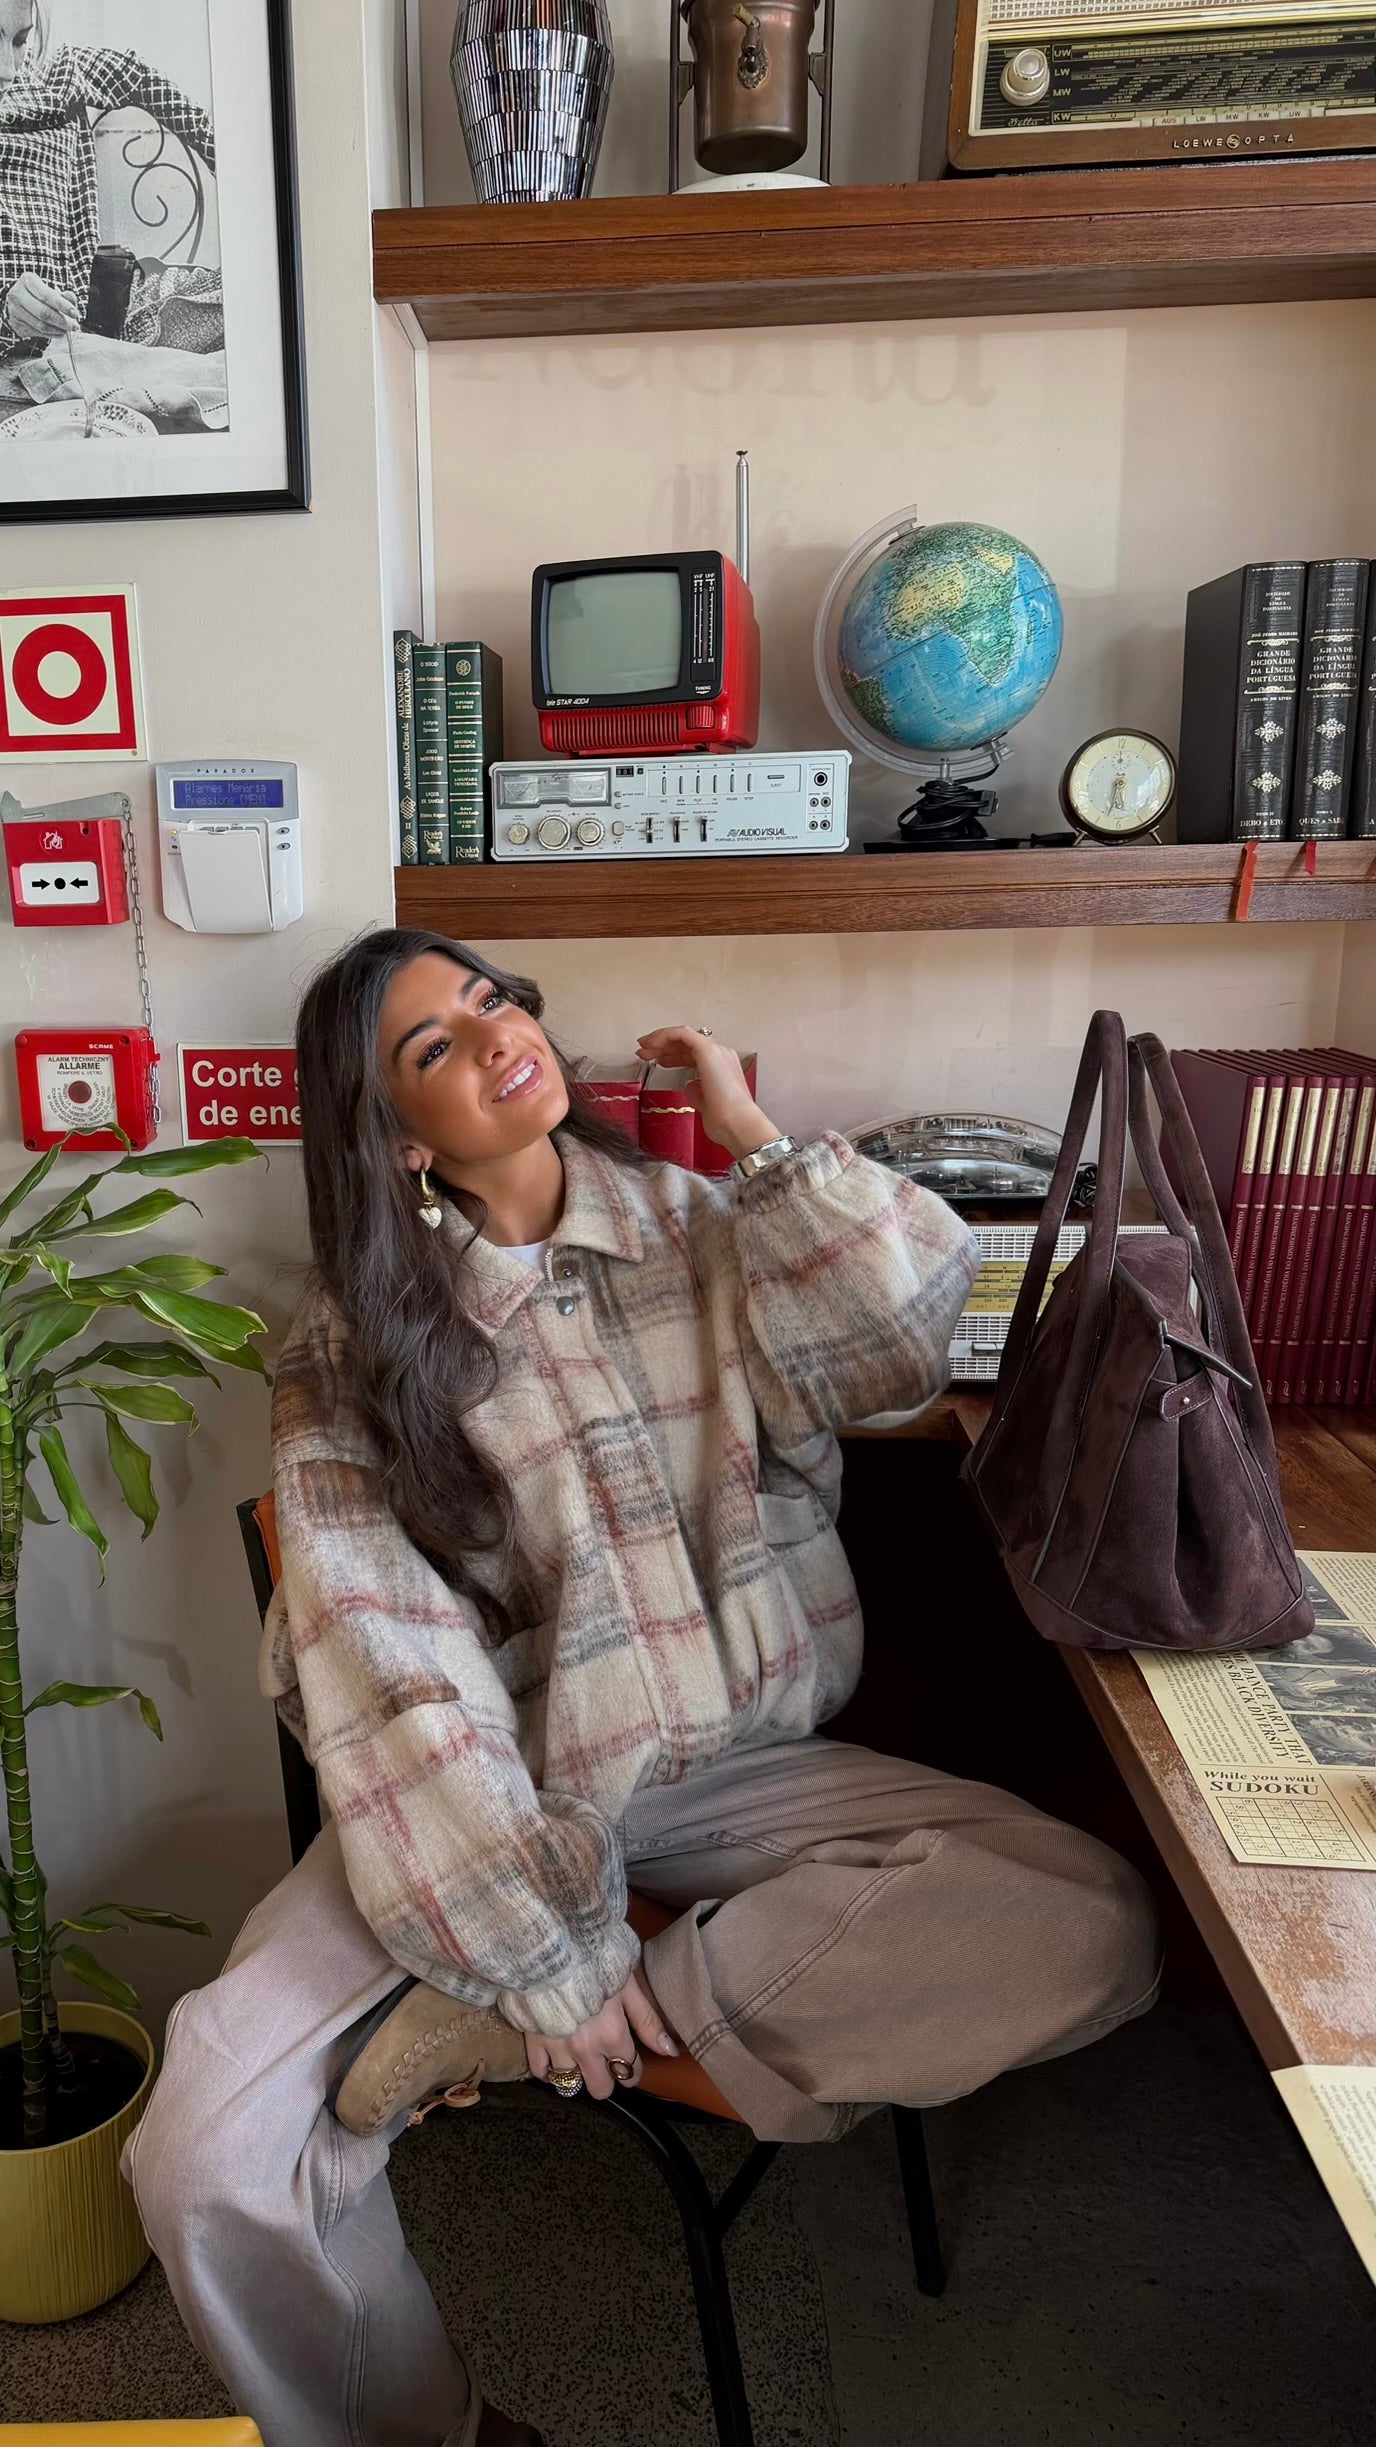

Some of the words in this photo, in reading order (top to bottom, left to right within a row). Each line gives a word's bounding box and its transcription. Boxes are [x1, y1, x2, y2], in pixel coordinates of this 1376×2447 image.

[1054, 49, 1071, 57] UW
[1054, 68, 1070, 76] LW
[1053, 88, 1071, 96] MW
[1054, 112, 1071, 121] KW
[1173, 138, 1223, 148] LOEWE
[1244, 134, 1294, 145] OPTA
[1250, 658, 1296, 666] DICIONÁRIO
[1265, 665, 1294, 674] LÍNGUA
[1246, 675, 1297, 683] PORTUGUESA
[397, 671, 405, 718] ALEXANDRE
[403, 668, 412, 718] HERCULANO
[401, 722, 409, 730] de
[401, 731, 410, 751] Obras
[1118, 737, 1126, 749] 12
[402, 751, 411, 780] Melhores
[184, 783, 223, 794] Alarmes
[403, 781, 411, 790] As
[185, 794, 235, 806] Pressione
[1116, 820, 1121, 829] 6
[1240, 819, 1262, 827] DEBO
[1299, 817, 1320, 825] QUES
[58, 1062, 101, 1070] ALLARME
[192, 1060, 282, 1088] Corte
[199, 1099, 239, 1126] de
[1232, 1211, 1245, 1258] CONHECIMENTO
[1251, 1211, 1262, 1259] CONHECIMENTO
[1268, 1211, 1281, 1259] CONHECIMENTO
[1287, 1212, 1299, 1260] CONHECIMENTO
[1304, 1213, 1317, 1261] CONHECIMENTO
[1339, 1211, 1352, 1260] CONHECIMENTO
[1249, 1259, 1255, 1269] DO
[1267, 1260, 1274, 1269] DO
[1285, 1260, 1292, 1270] DO
[1302, 1261, 1309, 1271] DO
[1337, 1260, 1344, 1269] DO
[1227, 1671, 1258, 1705] BLACK
[1248, 1706, 1293, 1760] DIVERSITY
[1241, 1667, 1270, 1700] DANCE
[1262, 1704, 1293, 1735] PARTY
[1285, 1738, 1313, 1766] THAT
[1204, 1770, 1248, 1780] While
[1252, 1773, 1279, 1782] you
[1284, 1774, 1316, 1783] wait
